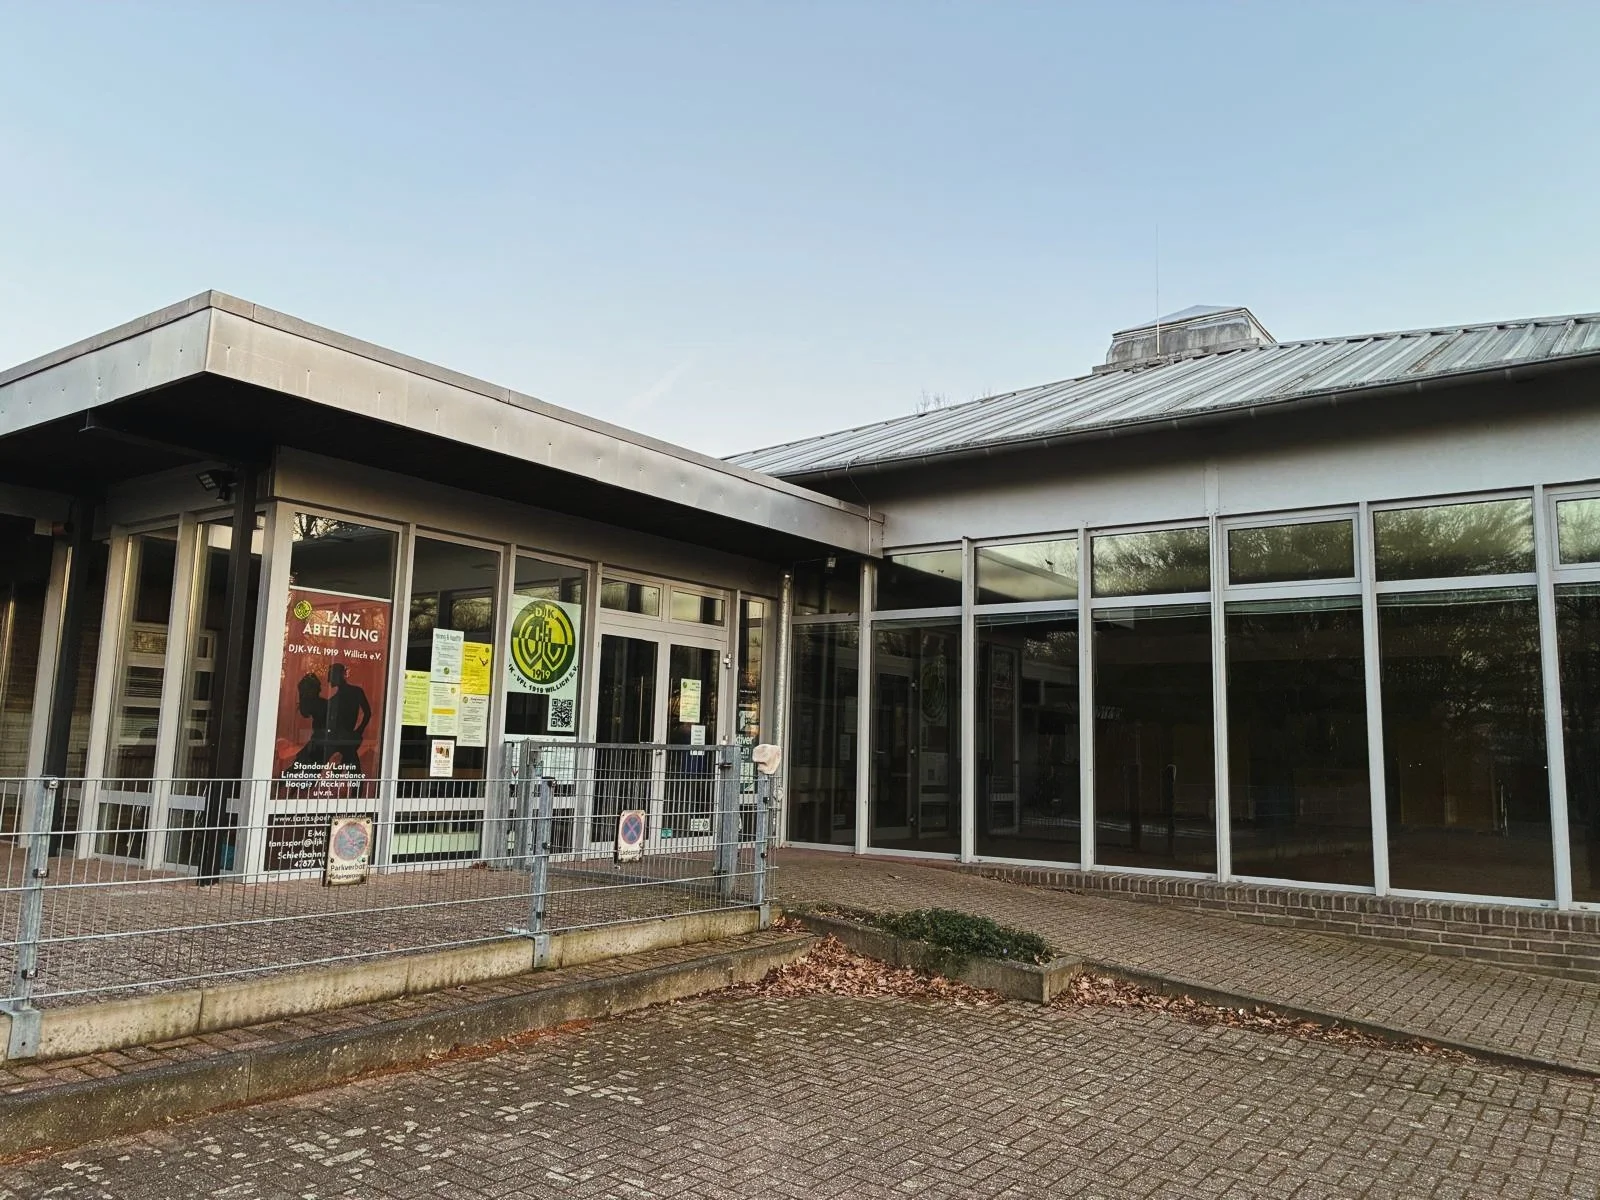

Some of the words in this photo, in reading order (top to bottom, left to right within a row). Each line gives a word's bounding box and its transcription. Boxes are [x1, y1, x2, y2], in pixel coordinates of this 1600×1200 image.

[325, 610, 361, 626] TANZ
[535, 607, 555, 619] DJK
[302, 622, 379, 642] ABTEILUNG
[288, 643, 321, 655] DJK-VfL
[323, 648, 339, 656] 1919
[343, 649, 368, 660] Willich
[369, 652, 382, 661] e.V.
[532, 669, 551, 680] 1919
[528, 684, 544, 693] 1919
[544, 676, 570, 693] WILLICH
[293, 761, 357, 771] Standard/Latein
[281, 770, 323, 779] Linedance,
[325, 771, 366, 779] Showdance
